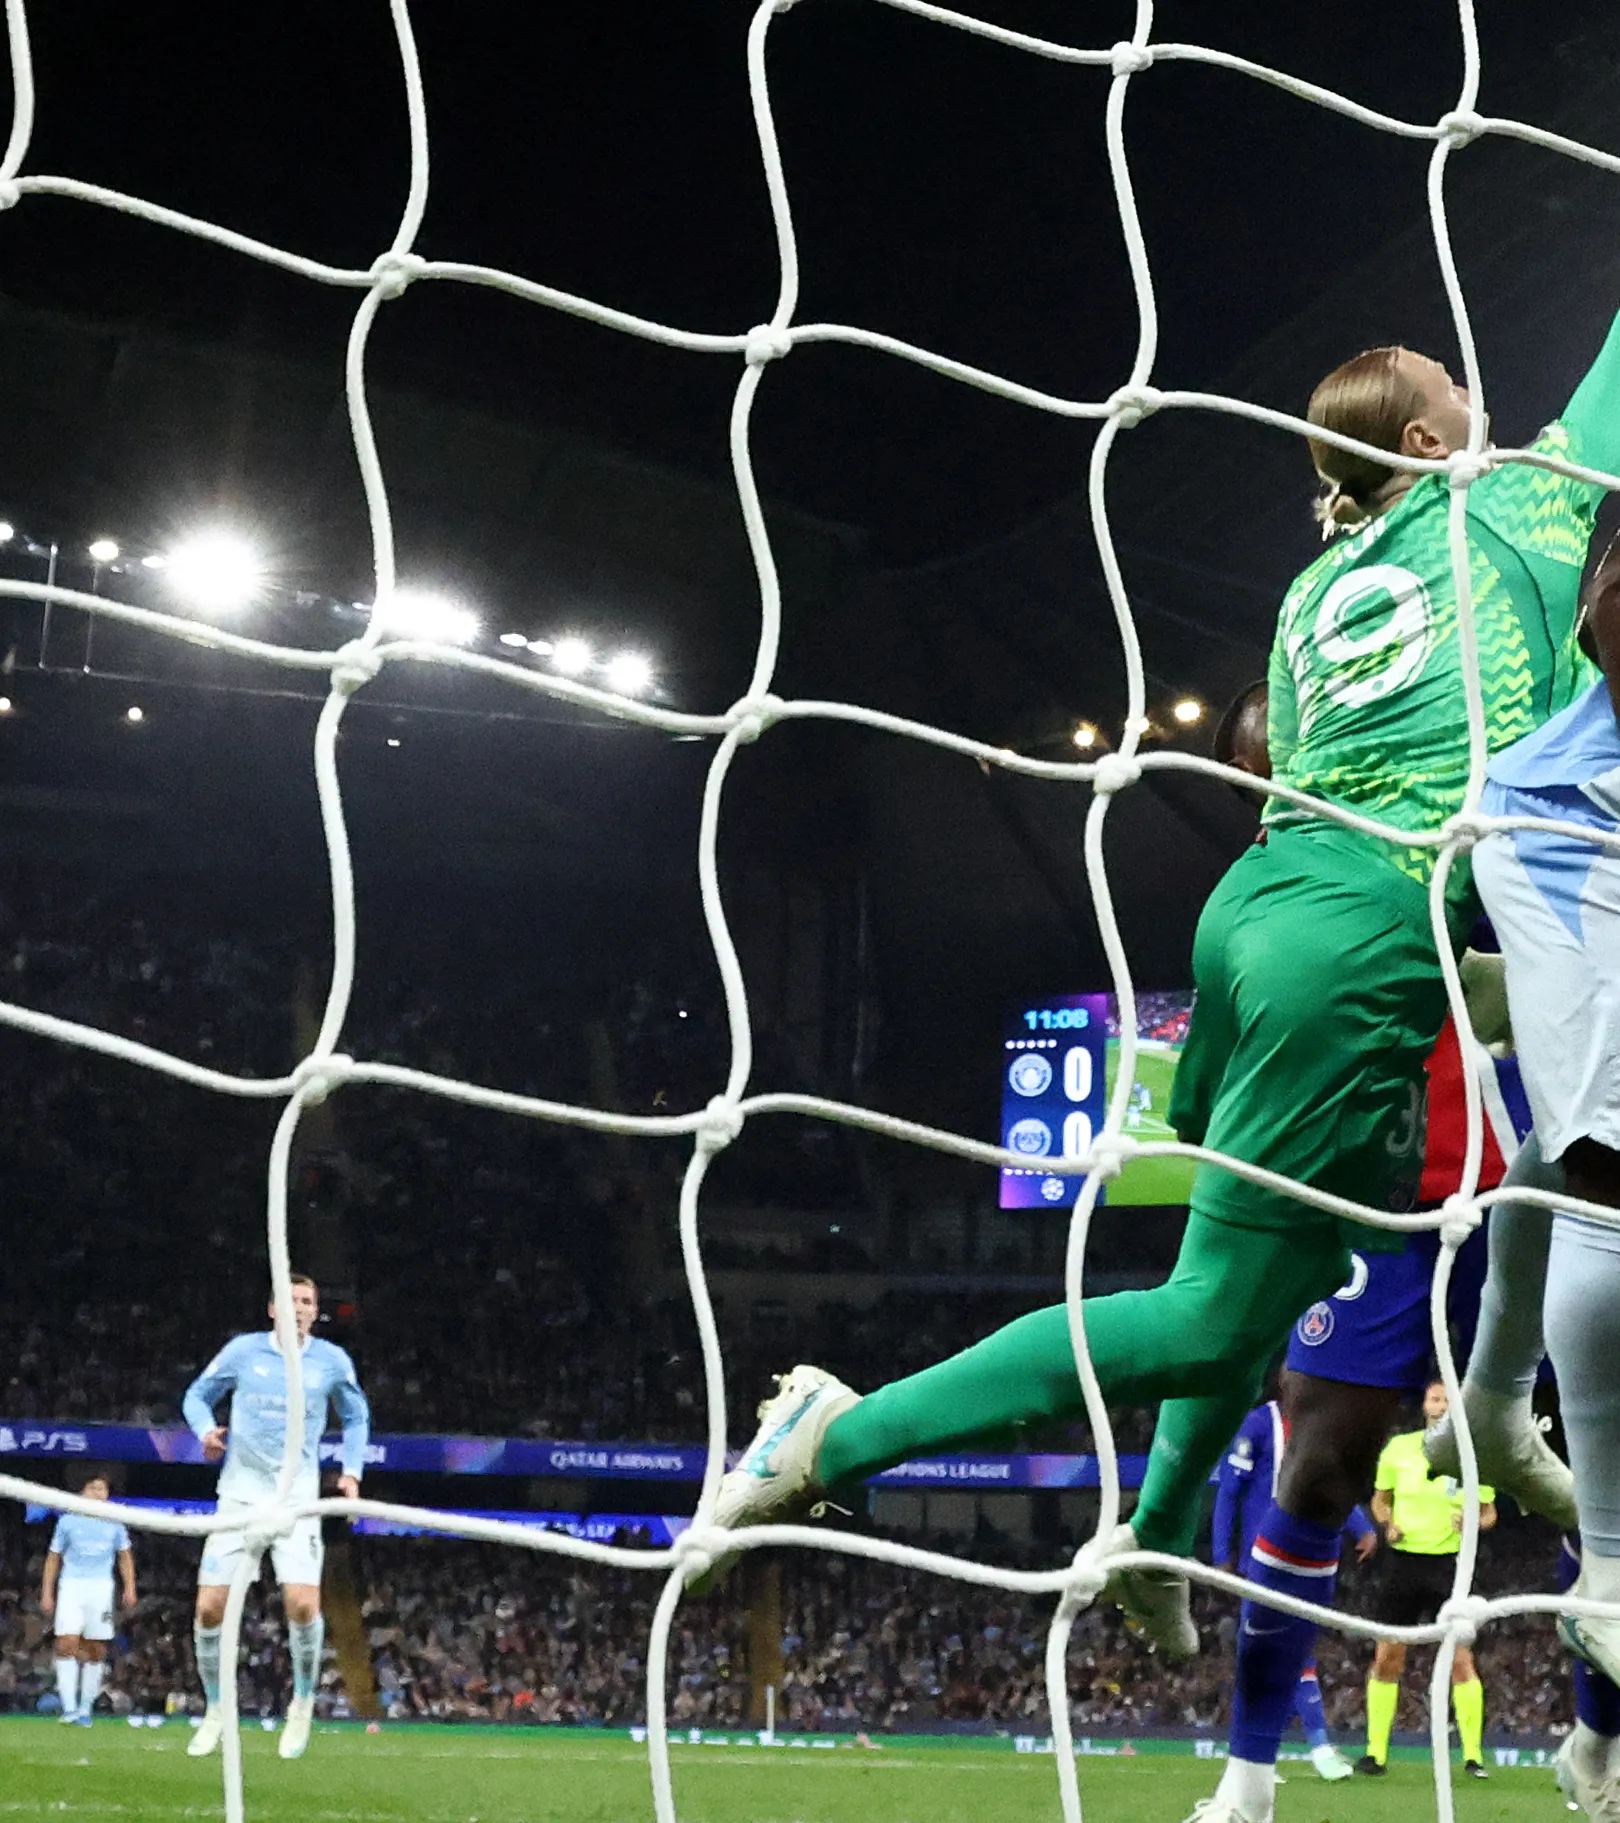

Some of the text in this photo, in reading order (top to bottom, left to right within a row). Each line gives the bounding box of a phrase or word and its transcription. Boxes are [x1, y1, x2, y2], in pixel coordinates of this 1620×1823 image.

[1023, 1007, 1089, 1031] 11:08
[1063, 1046, 1093, 1103] 0
[1062, 1111, 1092, 1161] 0
[22, 1431, 87, 1452] PS5
[549, 1450, 684, 1471] QATAR AIRWAYS
[949, 1462, 1011, 1479] LEAGUE
